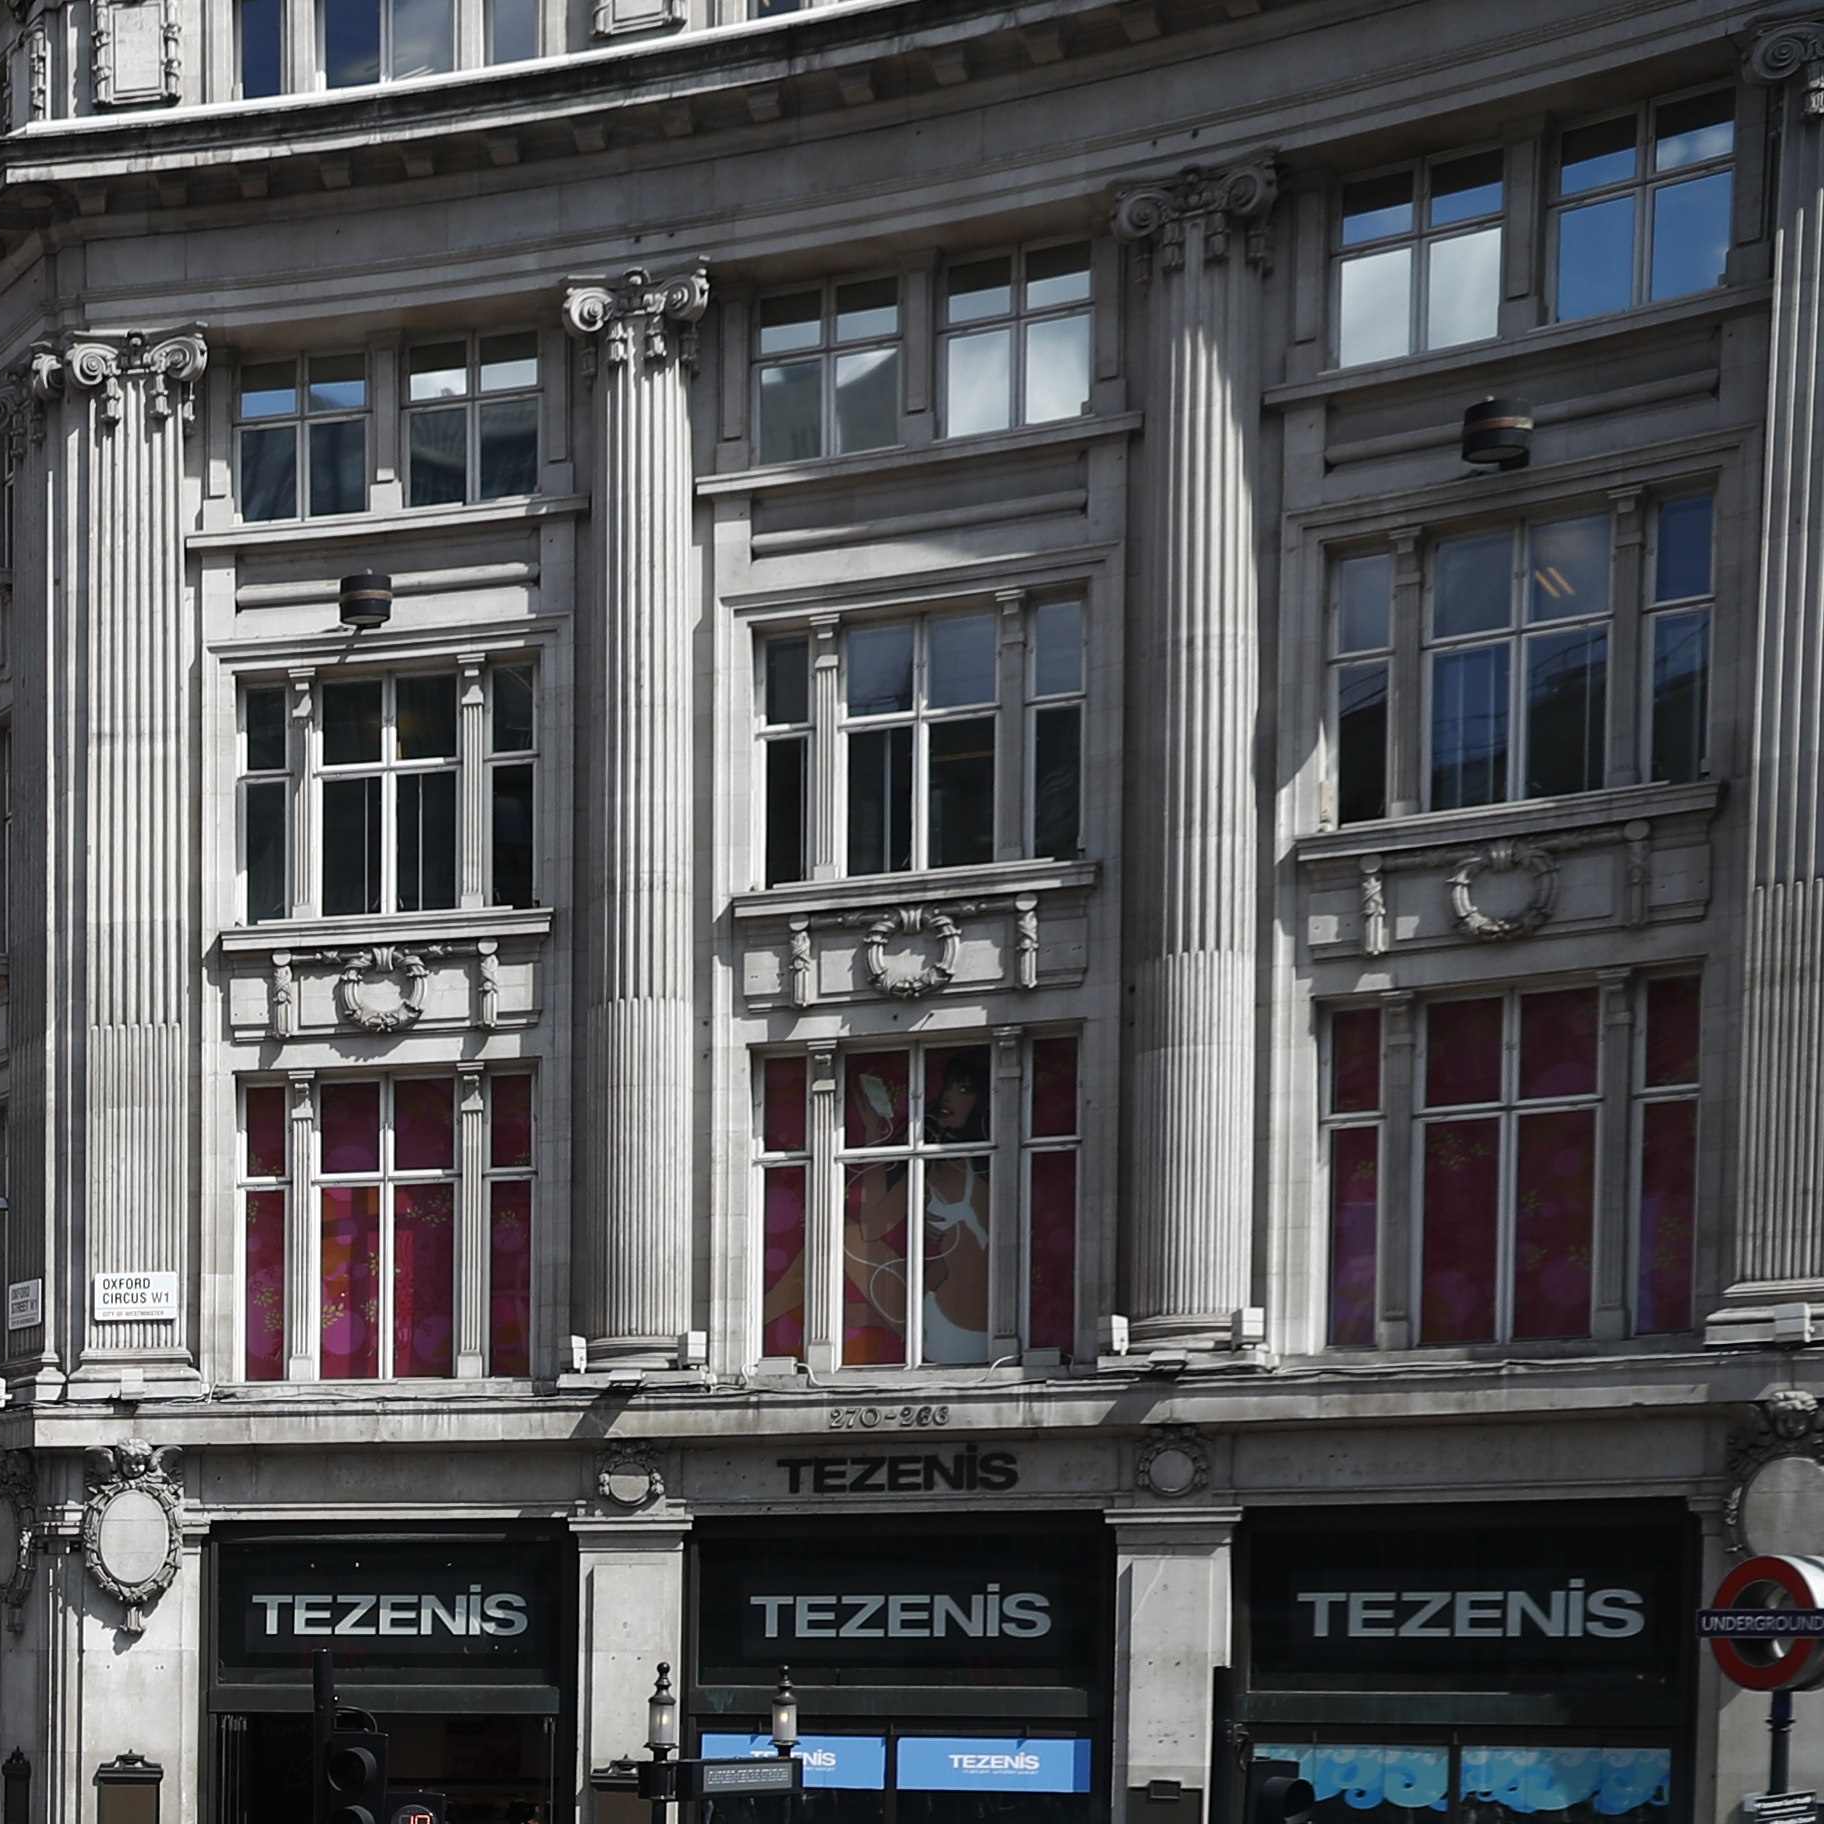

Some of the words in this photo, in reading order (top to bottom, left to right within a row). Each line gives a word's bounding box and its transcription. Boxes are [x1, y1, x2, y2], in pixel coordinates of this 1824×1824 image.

[102, 1277, 151, 1290] OXFORD
[102, 1292, 147, 1304] CIRCUS
[151, 1291, 170, 1303] W1
[1701, 1615, 1824, 1631] UNDERGROUND
